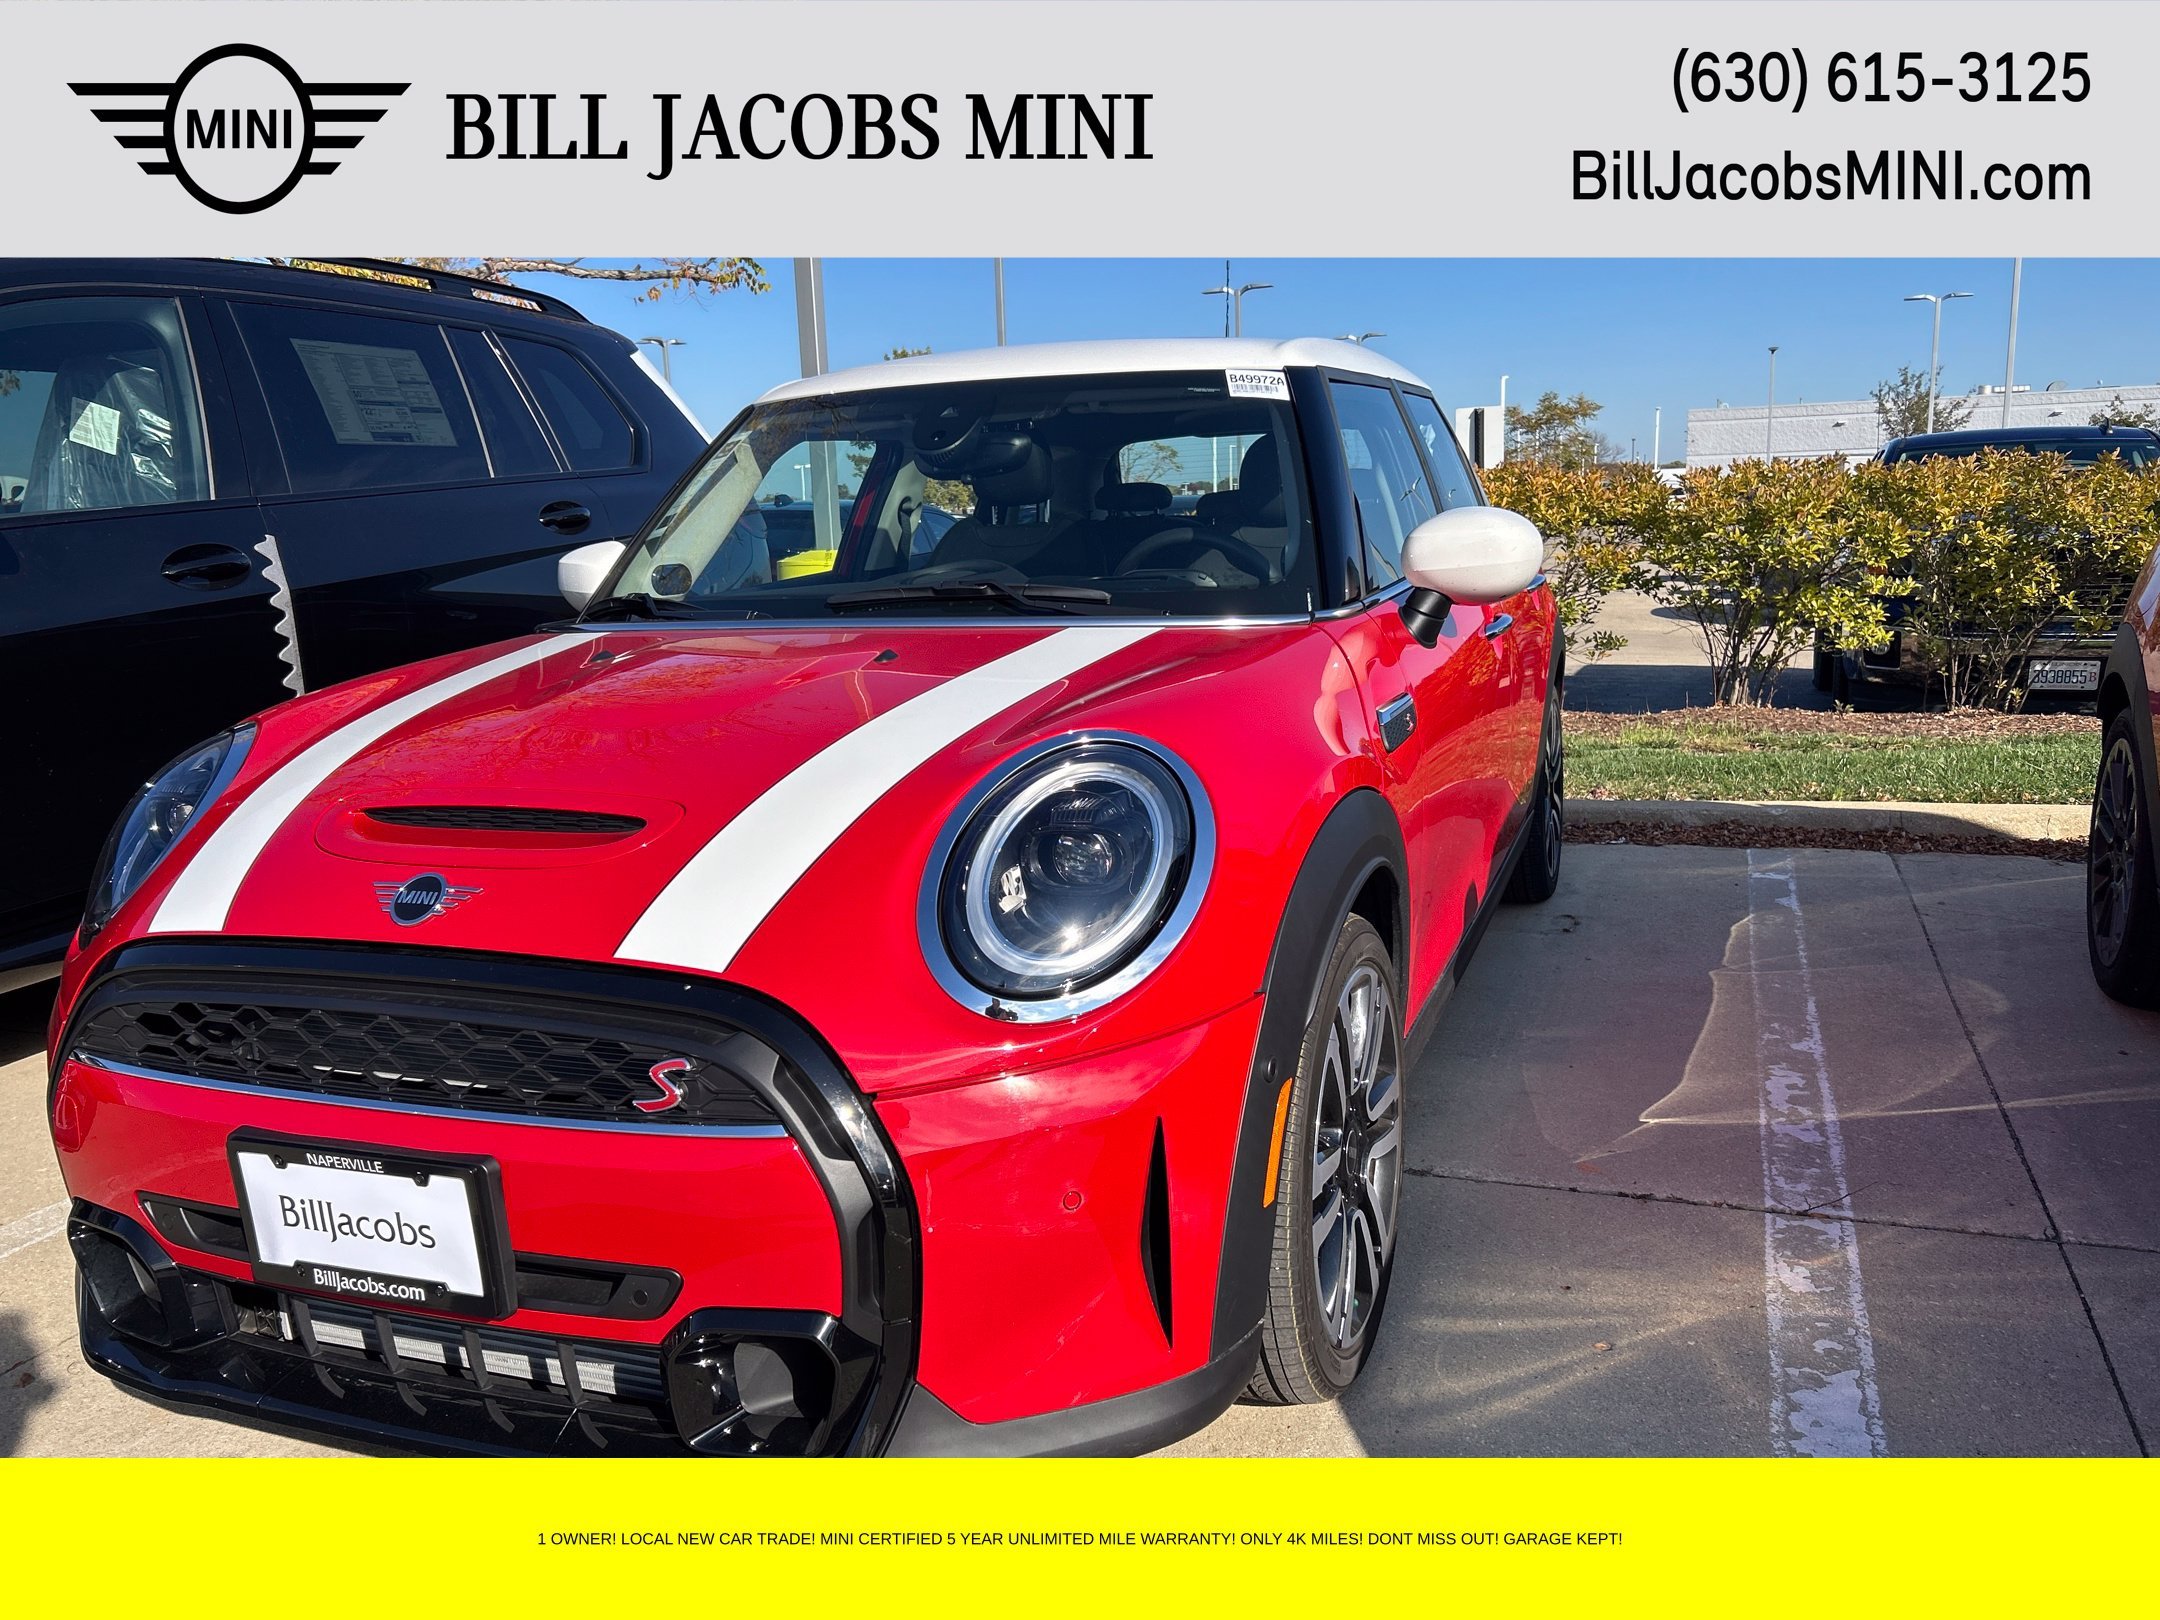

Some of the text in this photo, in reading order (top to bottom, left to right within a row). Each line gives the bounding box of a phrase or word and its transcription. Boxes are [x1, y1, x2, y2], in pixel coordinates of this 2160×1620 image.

[1229, 373, 1285, 386] B49972A
[397, 890, 439, 905] MINI
[632, 1058, 691, 1113] S
[305, 1153, 385, 1174] NAPERVILLE
[278, 1194, 437, 1249] BillJacobs
[312, 1267, 426, 1301] BillJacobs.com
